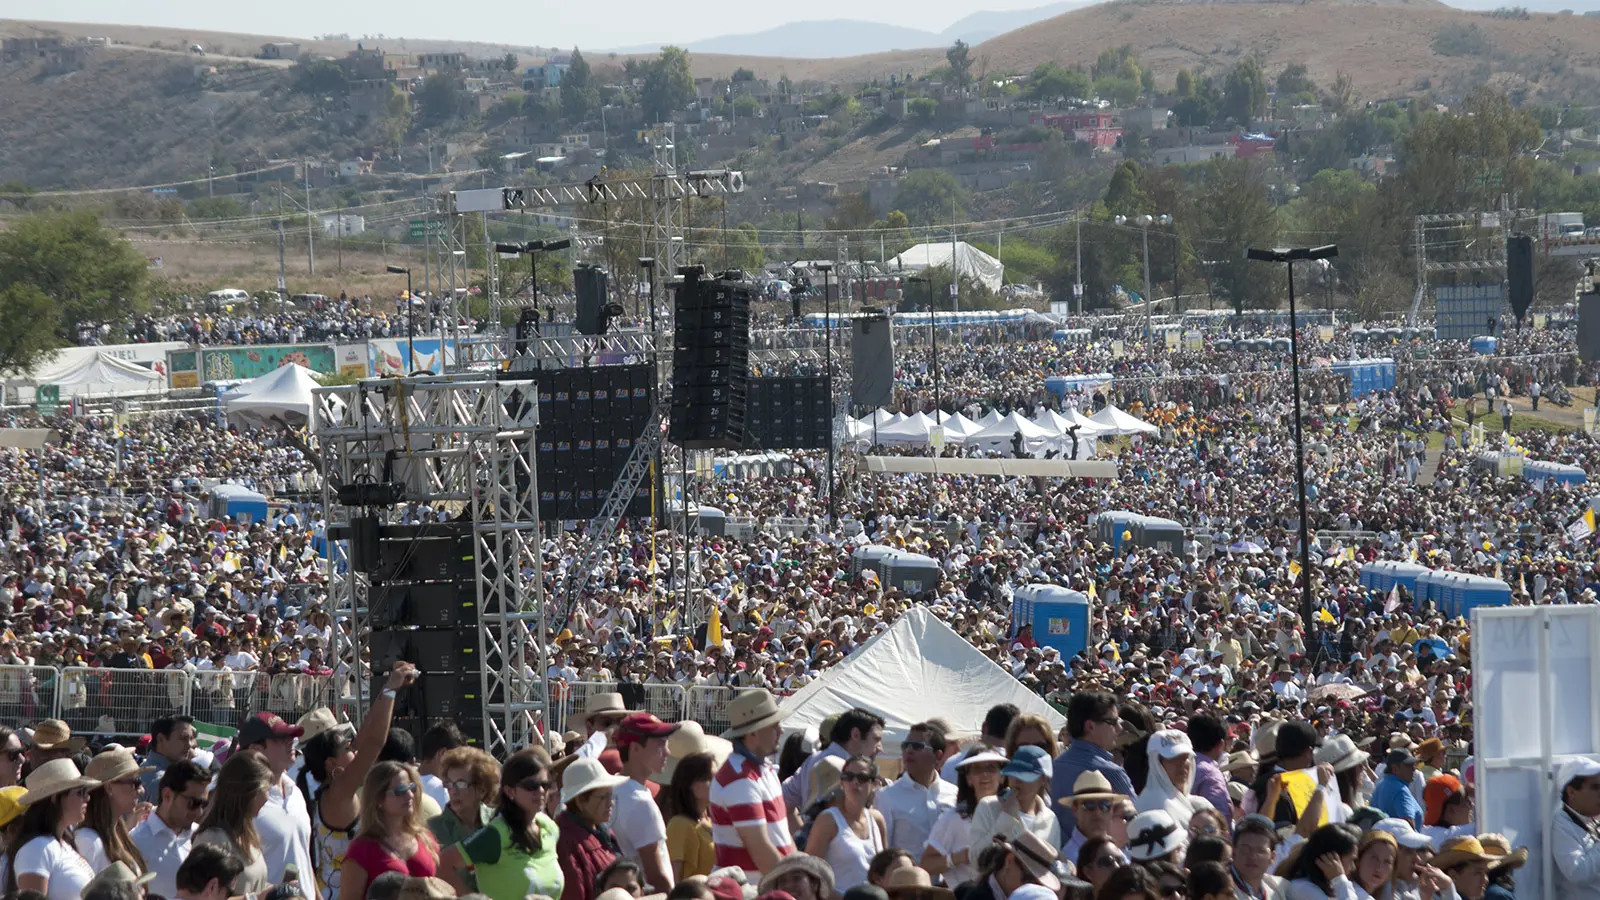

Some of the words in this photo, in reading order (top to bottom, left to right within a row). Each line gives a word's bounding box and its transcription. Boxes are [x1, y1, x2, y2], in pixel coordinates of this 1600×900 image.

[716, 291, 724, 300] 30
[713, 311, 721, 320] 35
[714, 331, 722, 339] 20
[715, 349, 720, 358] 5
[711, 369, 719, 378] 22
[711, 407, 719, 416] 26
[710, 425, 716, 433] 9
